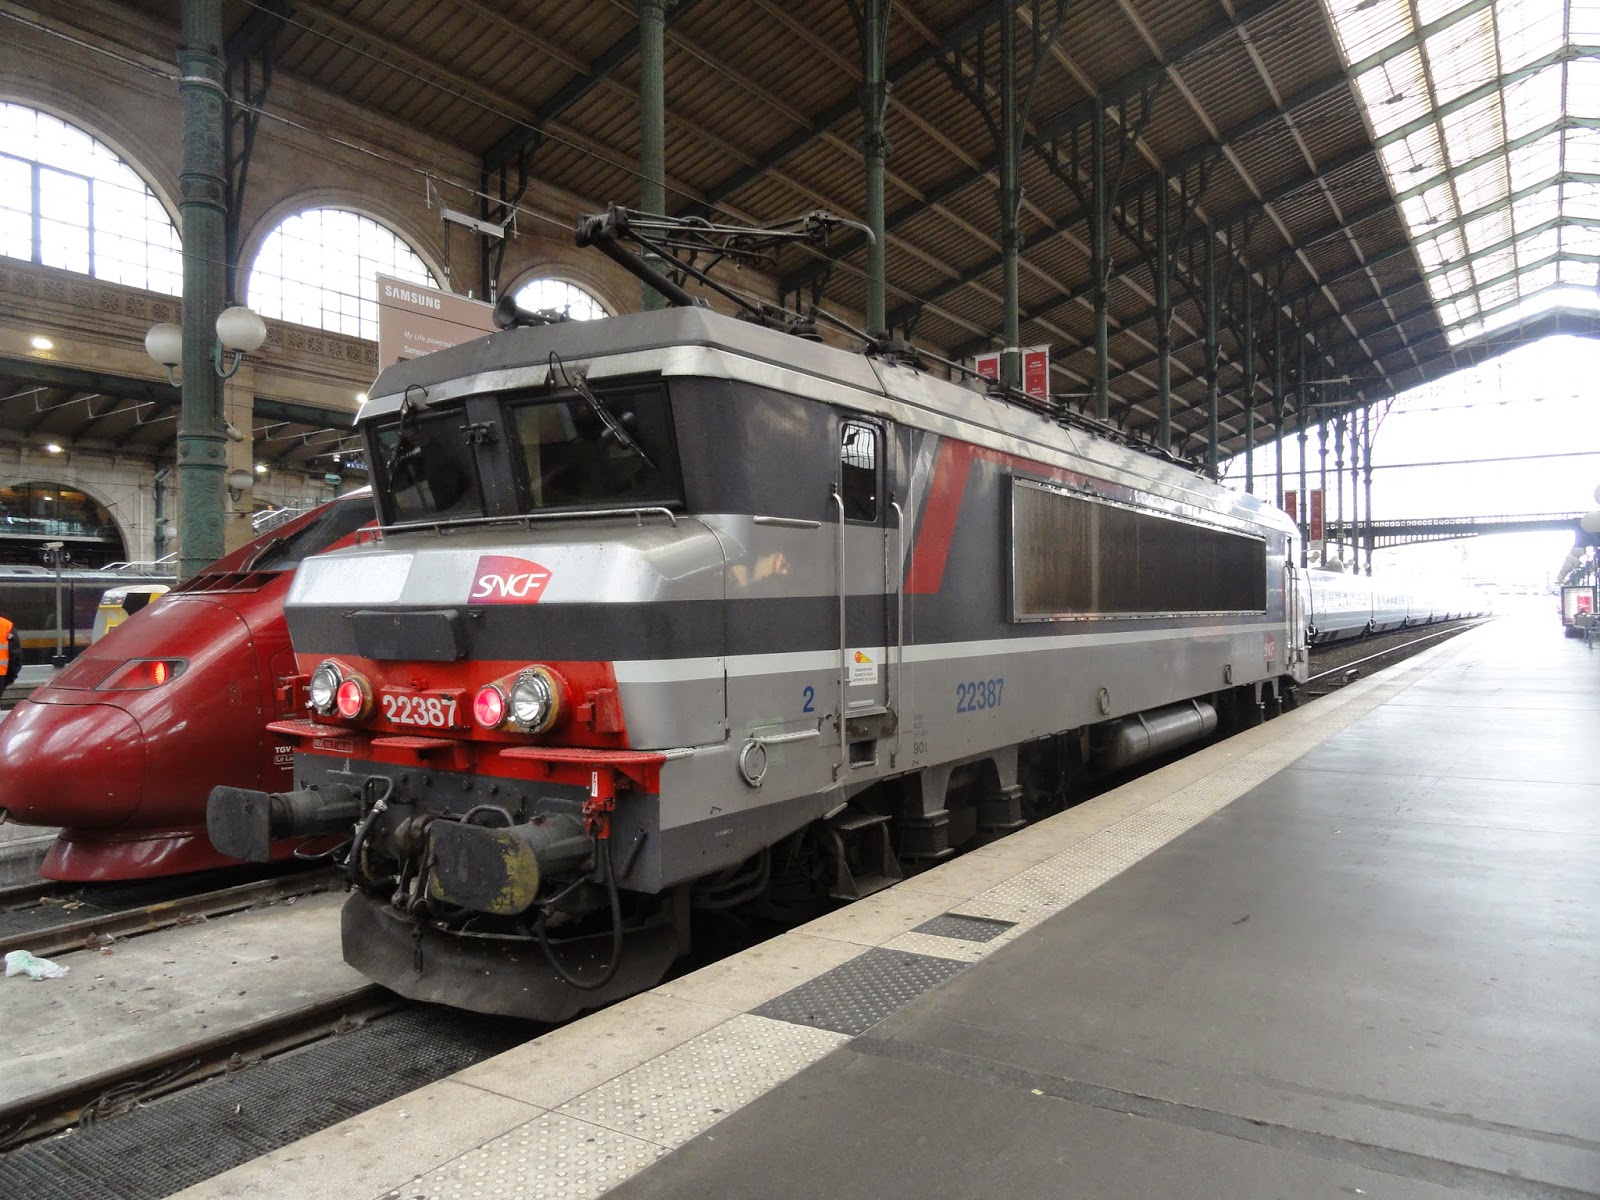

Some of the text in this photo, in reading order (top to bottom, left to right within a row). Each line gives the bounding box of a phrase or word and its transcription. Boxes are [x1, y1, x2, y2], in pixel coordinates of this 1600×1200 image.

[385, 285, 441, 309] SAMSUNG
[403, 331, 413, 340] My
[426, 337, 452, 348] powered
[472, 573, 548, 598] SNCF
[802, 685, 815, 713] 2
[956, 678, 1004, 714] 22387
[382, 694, 456, 727] 22387
[274, 746, 291, 754] TGV
